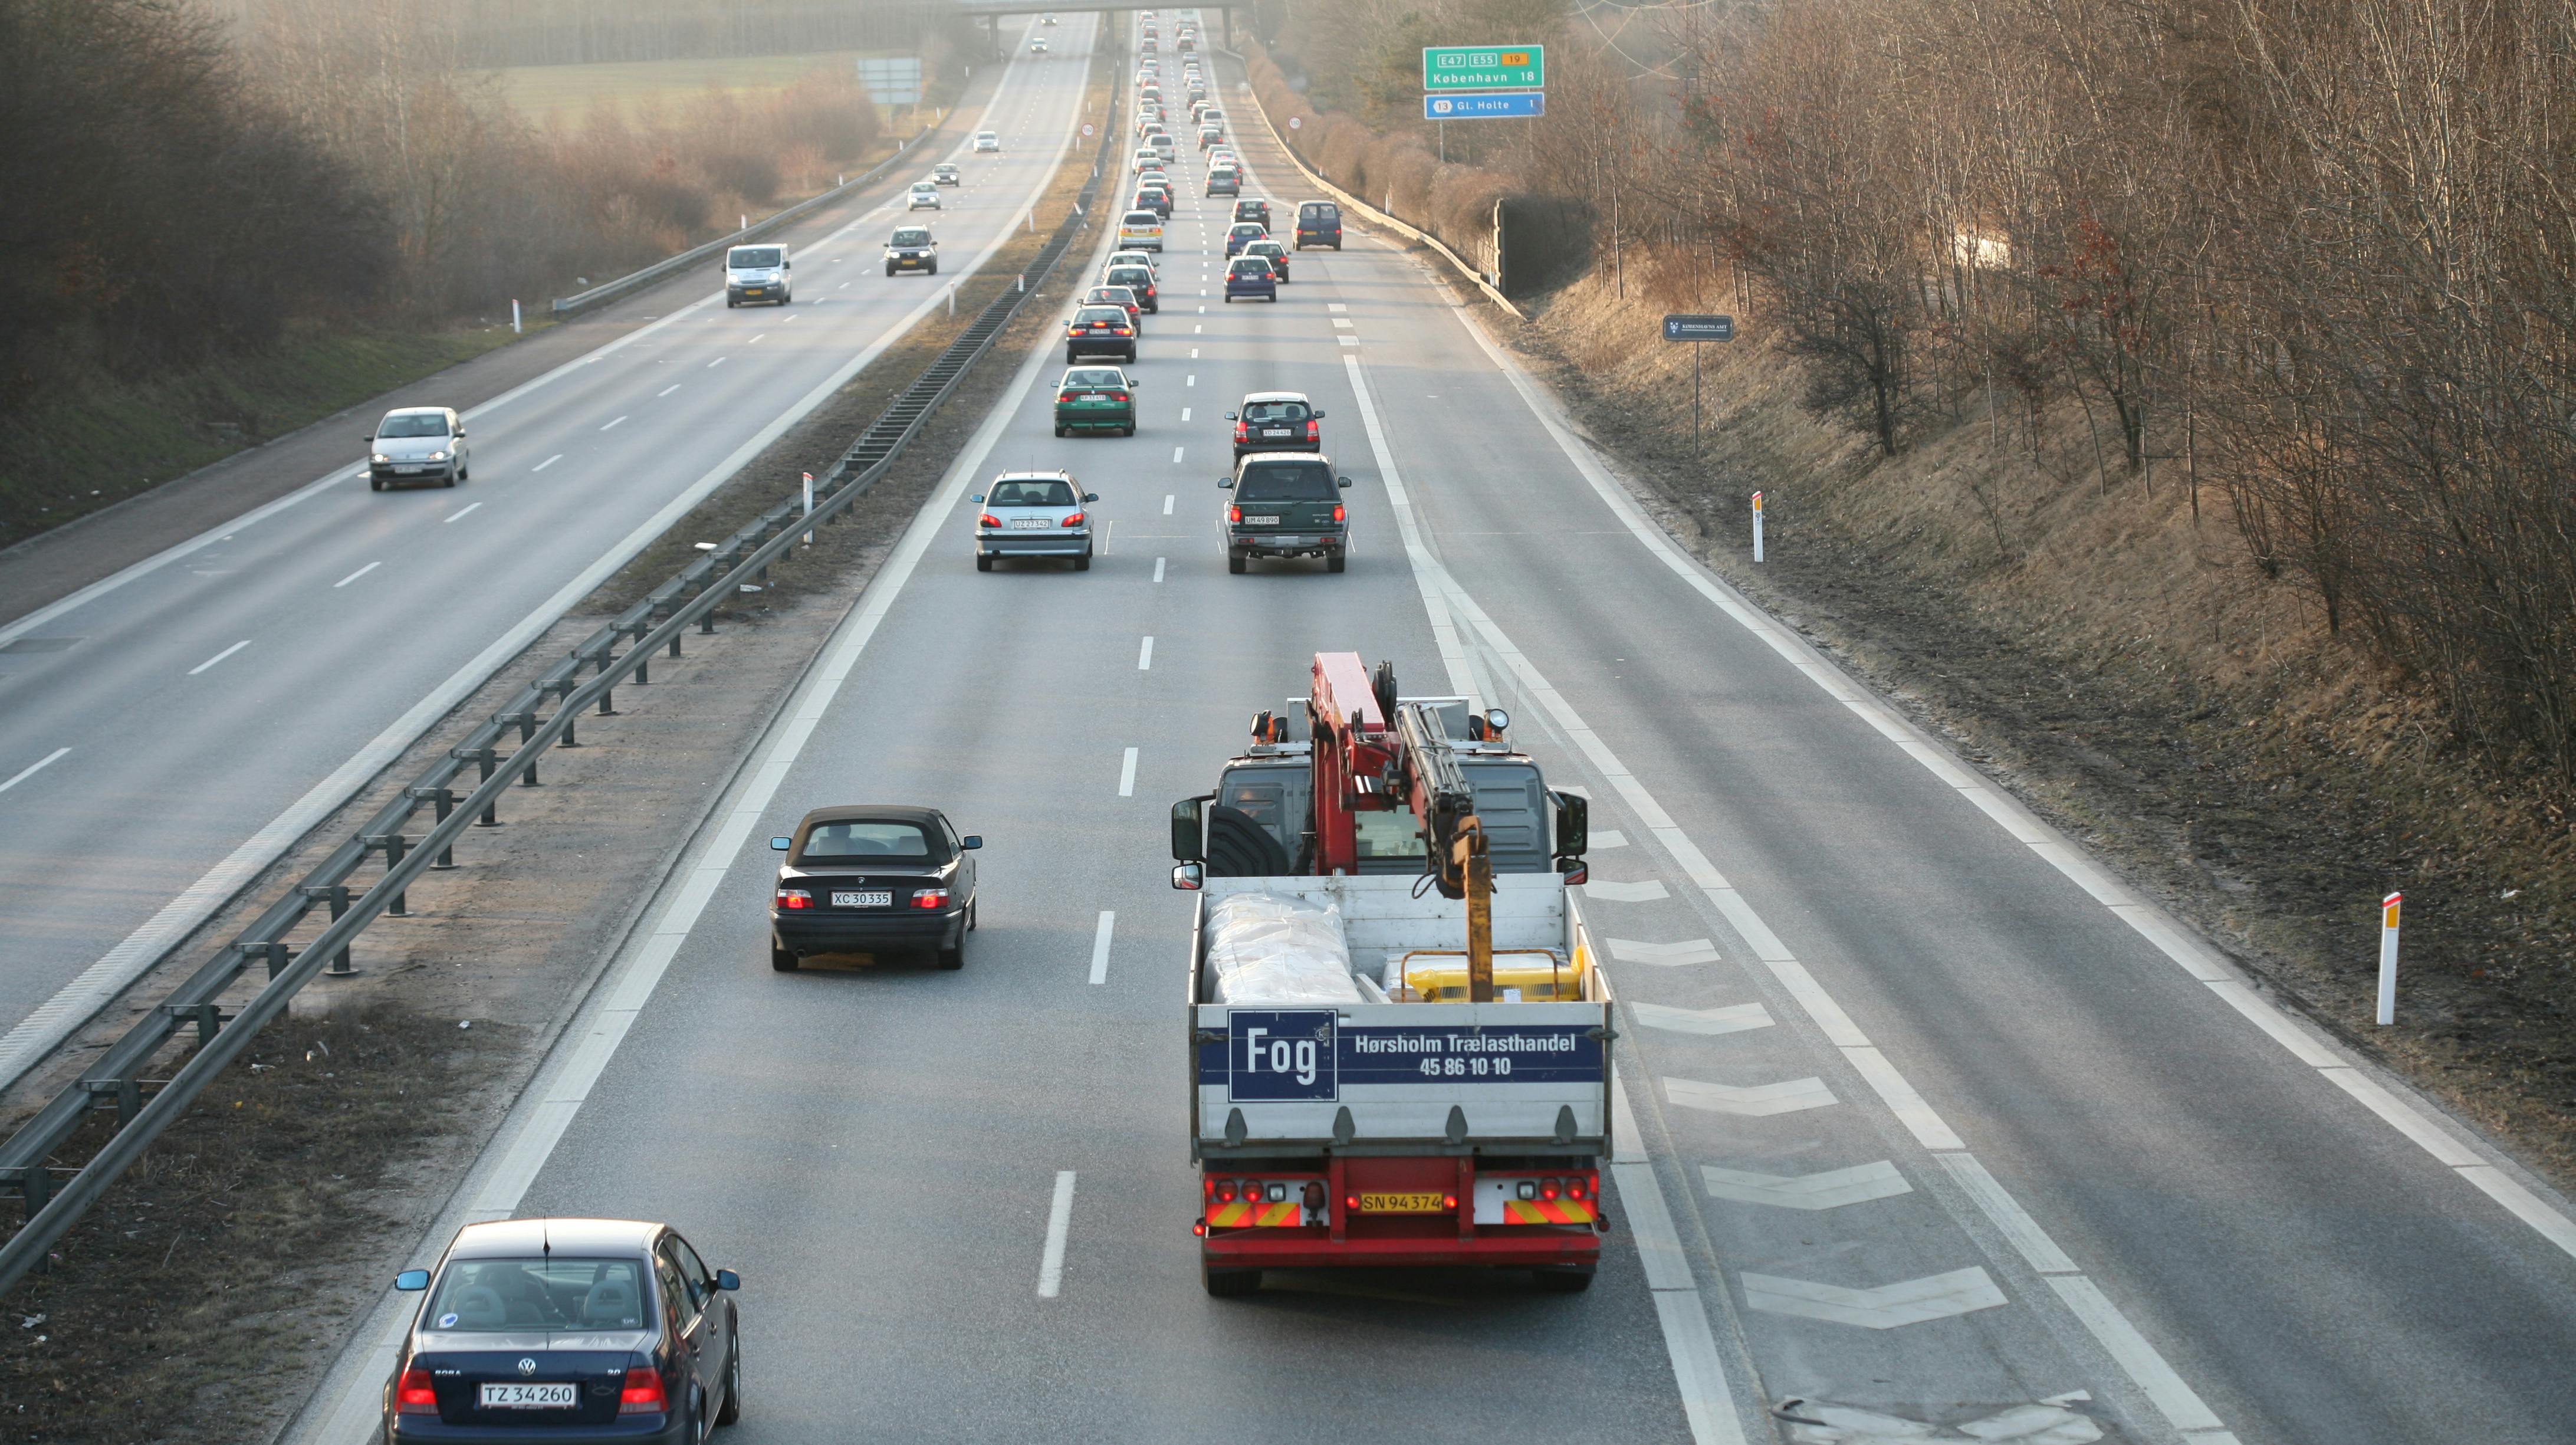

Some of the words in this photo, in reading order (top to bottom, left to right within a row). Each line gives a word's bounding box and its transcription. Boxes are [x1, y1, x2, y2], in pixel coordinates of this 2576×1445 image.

[1441, 57, 1462, 65] E47
[1473, 55, 1493, 64] E55
[1433, 73, 1507, 84] København
[1520, 71, 1535, 81] 18
[1437, 103, 1448, 111] 13
[1457, 101, 1473, 110] Gl.
[1478, 100, 1509, 109] Holte
[1530, 99, 1534, 108] 1
[834, 894, 850, 904] XC
[853, 894, 866, 904] 30
[869, 894, 889, 904] 335
[1355, 1035, 1442, 1053] Hørsholm
[1447, 1033, 1576, 1053] Trælasthandel
[1248, 1028, 1316, 1085] Fog
[1420, 1058, 1440, 1076] 45
[1444, 1058, 1465, 1076] 86
[1470, 1058, 1489, 1075] 10
[1492, 1058, 1511, 1075] 10
[1363, 1196, 1385, 1209] SN
[1389, 1196, 1408, 1209] 94
[1411, 1196, 1440, 1209] 374
[485, 1387, 508, 1402] TZ
[513, 1387, 535, 1402] 34
[539, 1387, 572, 1402] 260
